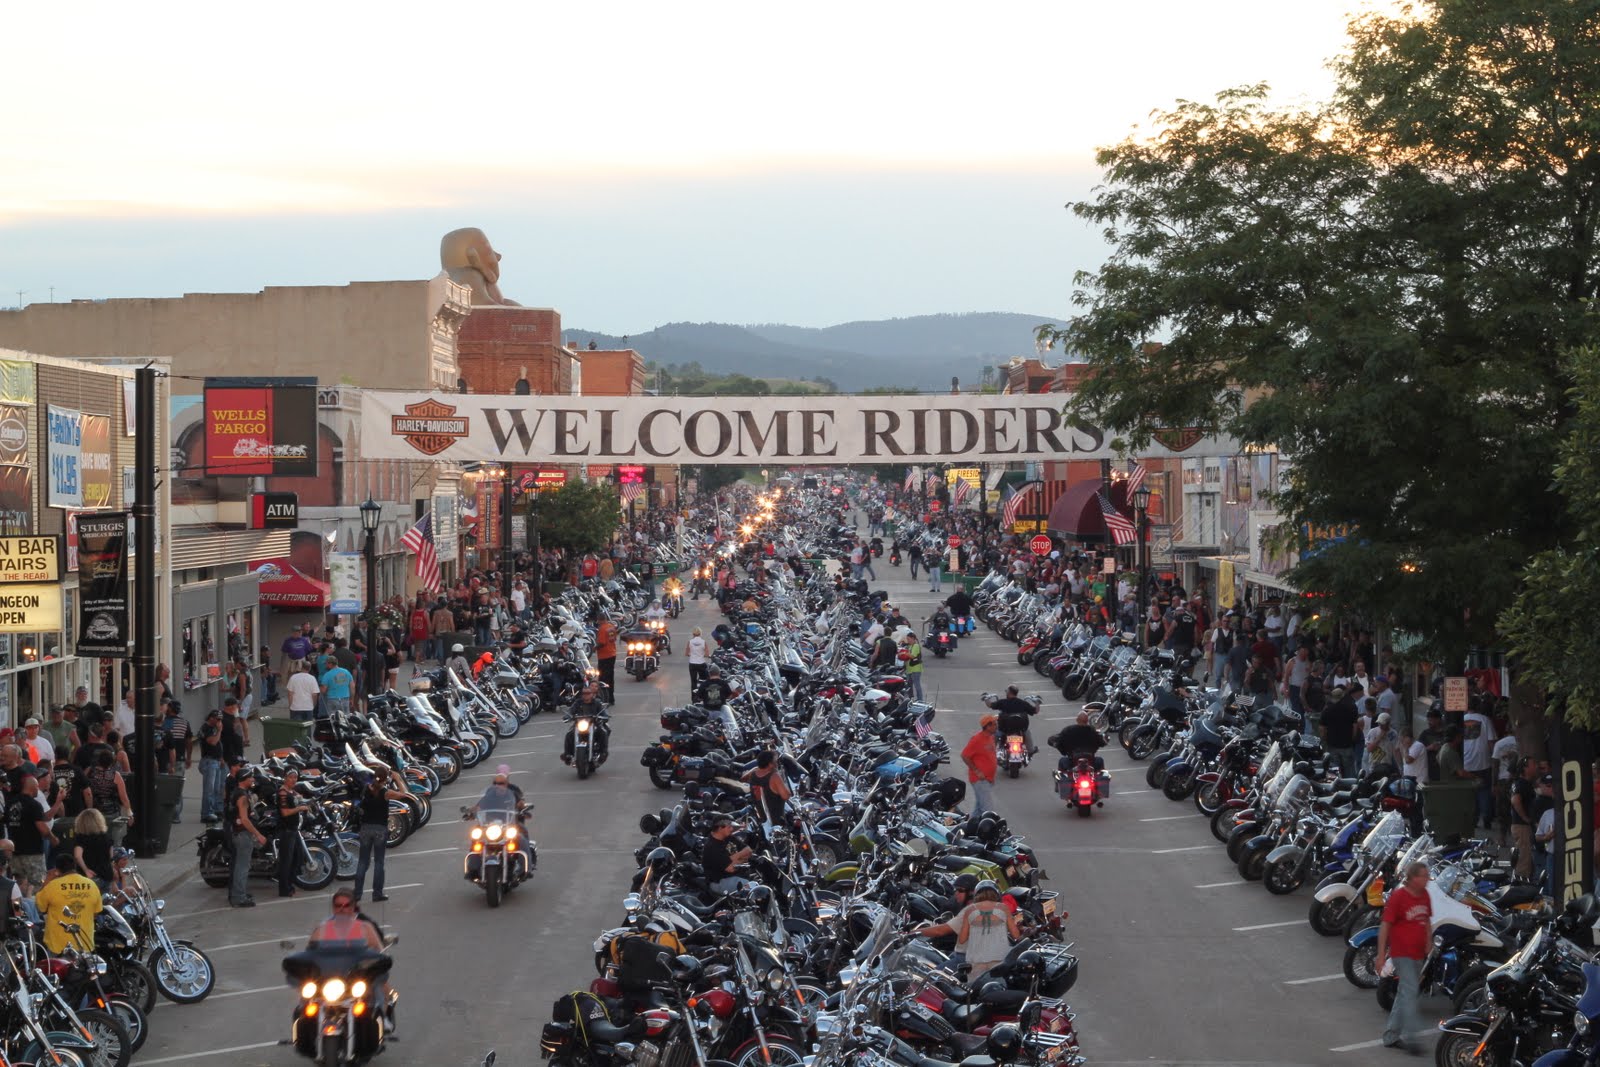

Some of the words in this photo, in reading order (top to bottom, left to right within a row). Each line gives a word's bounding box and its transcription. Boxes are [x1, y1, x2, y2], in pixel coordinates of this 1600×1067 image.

[212, 410, 266, 421] WELLS
[412, 403, 449, 416] MOTOR
[214, 423, 266, 434] FARGO
[396, 419, 465, 433] HARLEY-DAVIDSON
[480, 408, 838, 457] WELCOME
[859, 407, 1104, 457] RIDERS
[412, 435, 448, 451] CYCLES
[81, 452, 94, 470] SAVE
[957, 470, 981, 478] FIRESID
[266, 504, 295, 516] ATM
[80, 522, 124, 533] STURGIS
[18, 539, 54, 555] BAR
[1032, 541, 1050, 550] STOP
[3, 573, 19, 581] THE
[23, 572, 49, 580] REAR)
[0, 595, 39, 609] NGEON
[281, 594, 318, 602] ATTORNEYS
